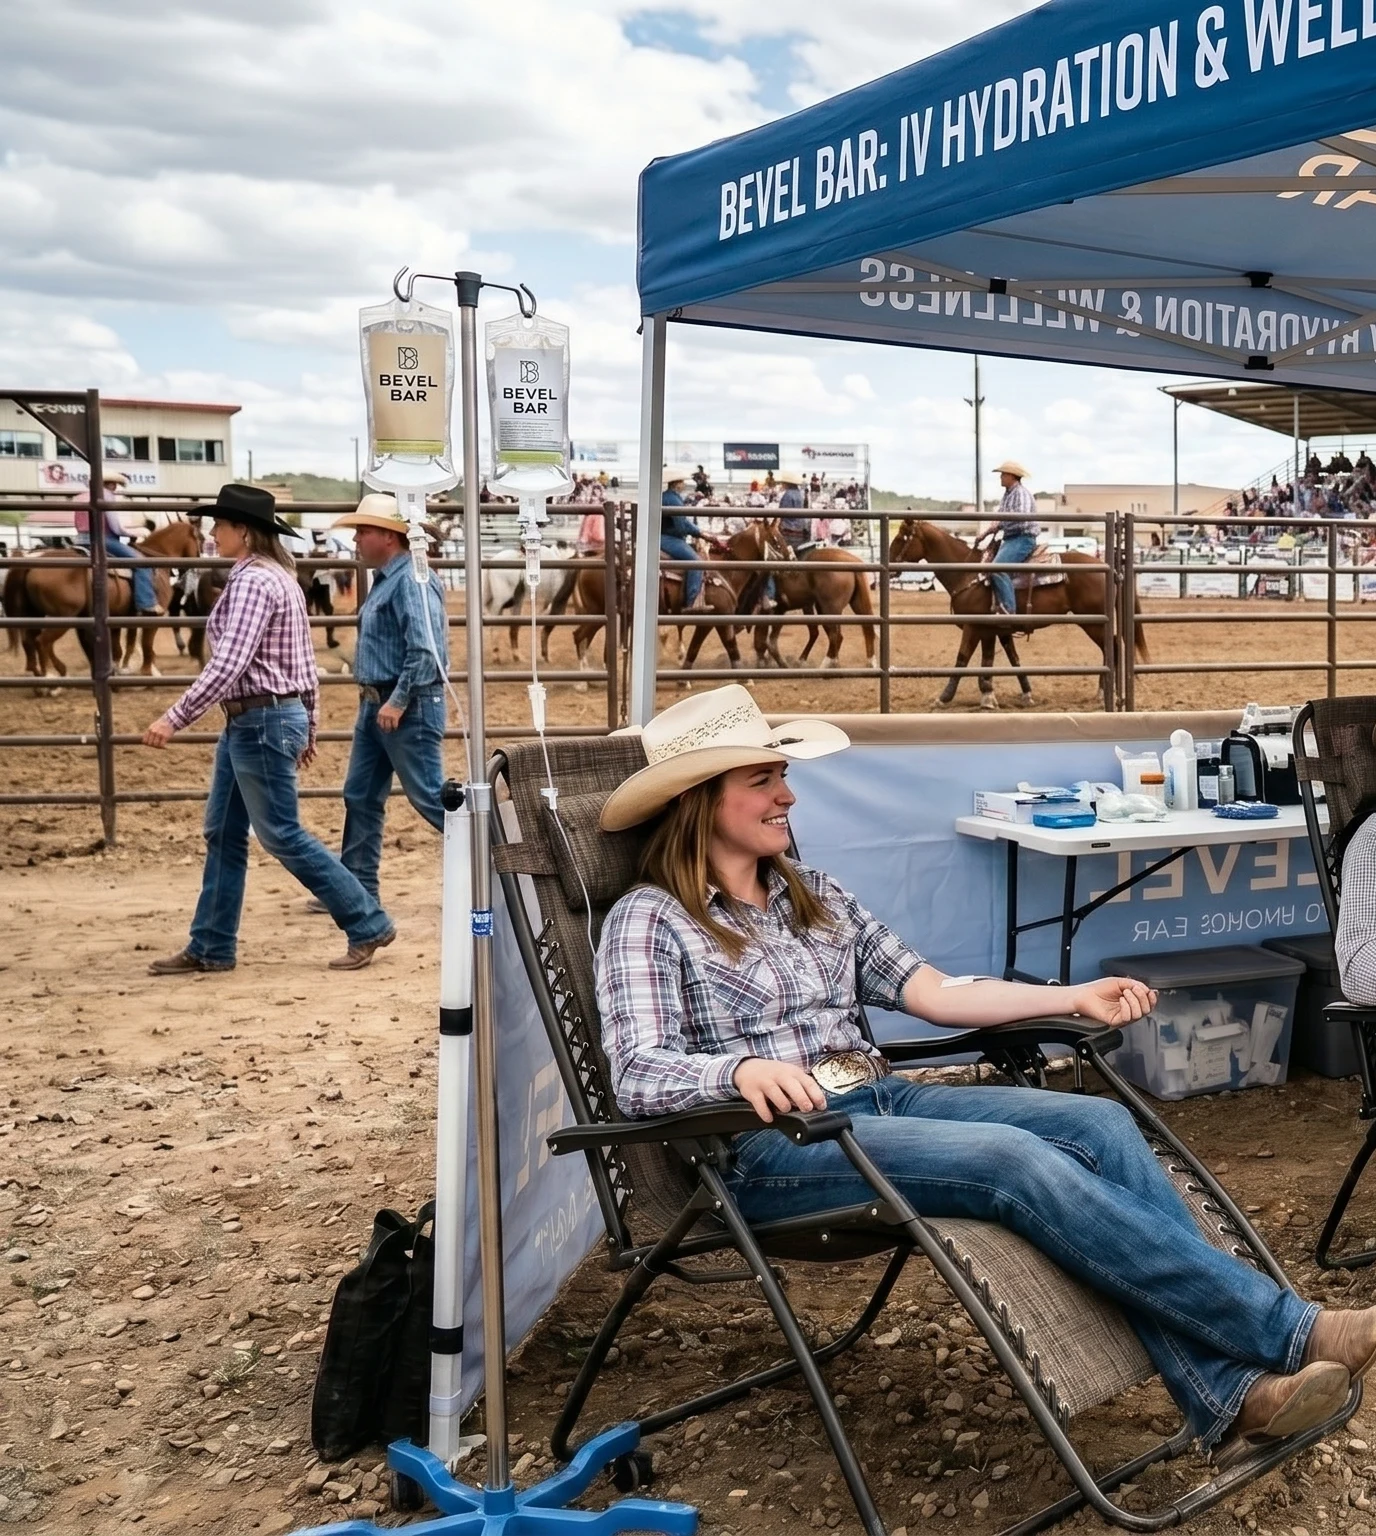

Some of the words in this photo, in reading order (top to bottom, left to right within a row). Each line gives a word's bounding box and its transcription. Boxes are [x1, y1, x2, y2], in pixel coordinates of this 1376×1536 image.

[719, 156, 806, 241] BEVEL
[815, 129, 888, 210] BAR:
[900, 106, 933, 182] IV
[942, 20, 1178, 168] HYDRATION
[1194, 5, 1229, 88] &
[379, 375, 438, 387] BEVEL
[391, 390, 427, 402] BAR
[503, 388, 558, 400] BEVEL
[513, 402, 548, 414] BAR
